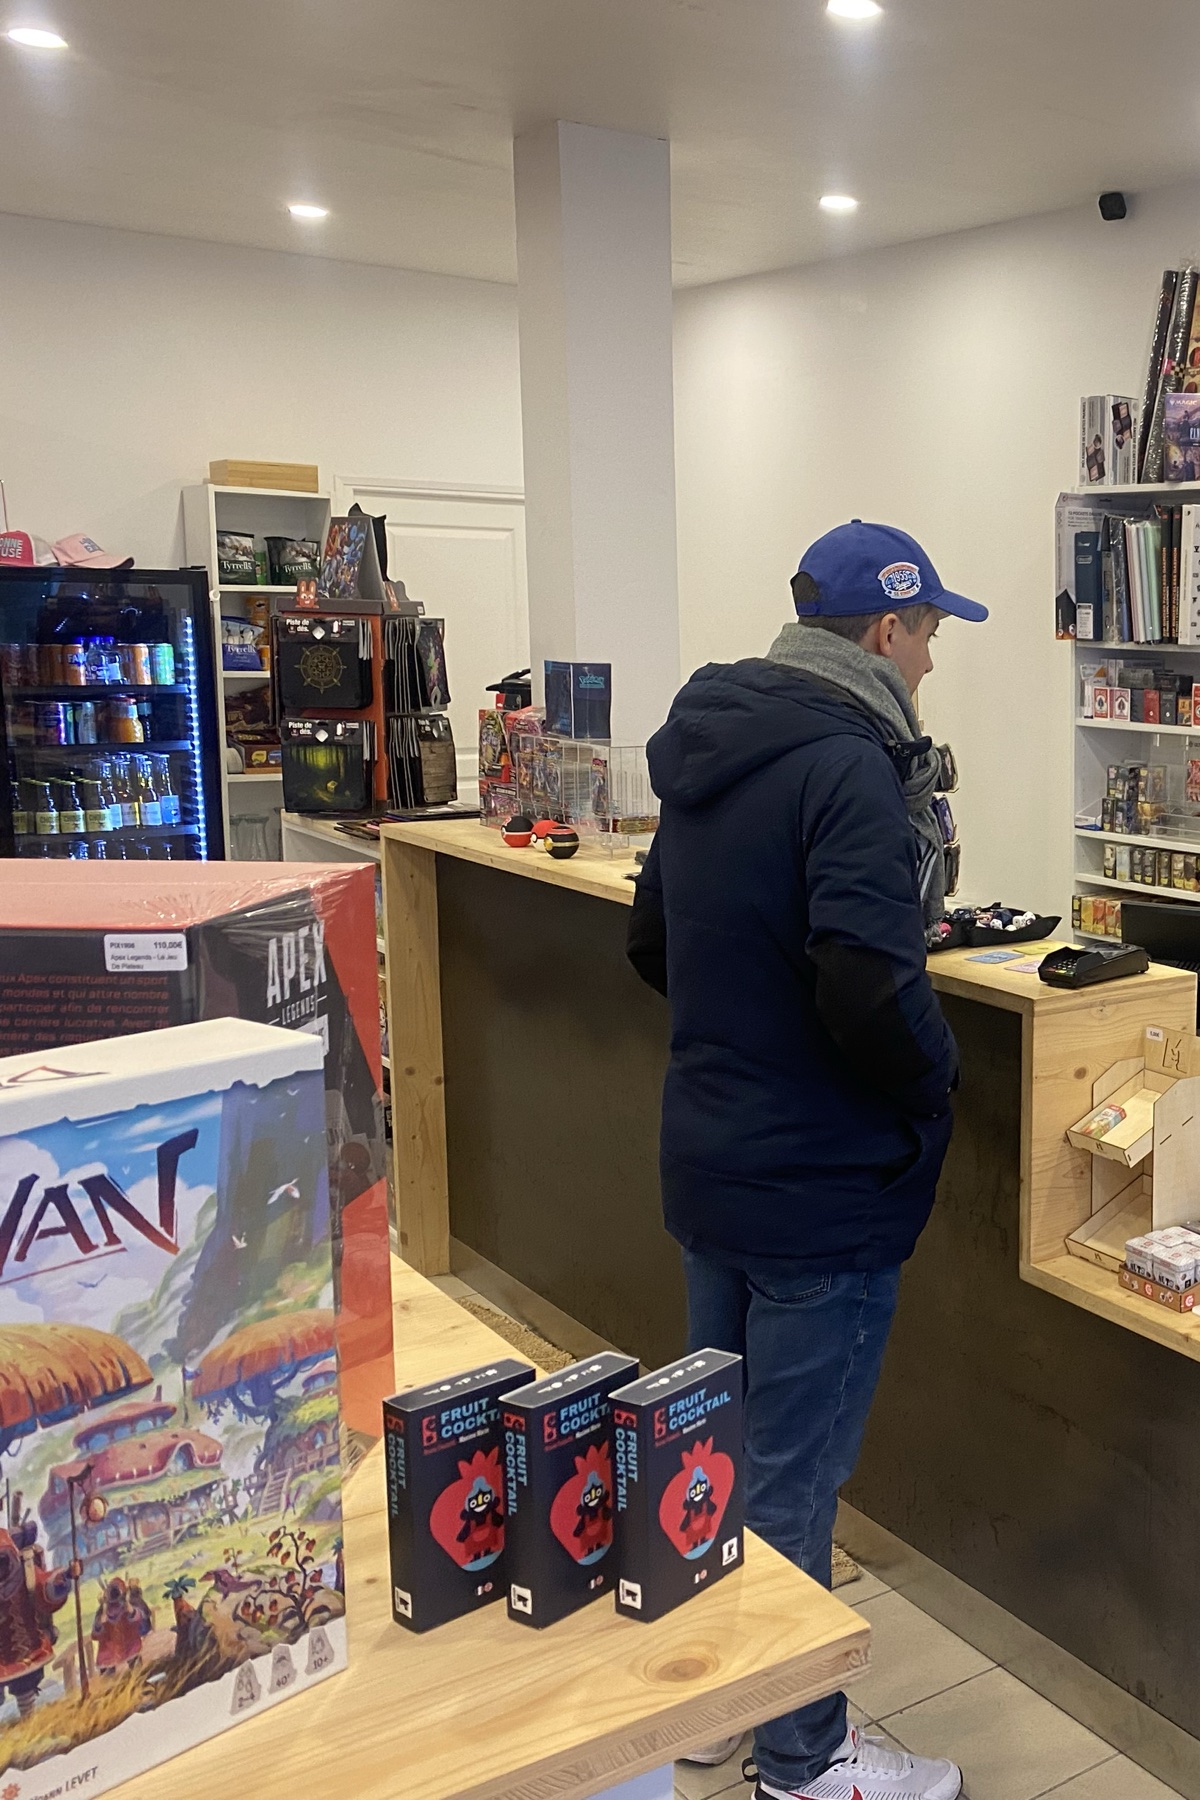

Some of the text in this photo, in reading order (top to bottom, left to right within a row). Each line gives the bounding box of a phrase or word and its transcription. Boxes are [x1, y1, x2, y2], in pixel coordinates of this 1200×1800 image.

[110, 954, 126, 962] Apex
[127, 954, 152, 962] Legends
[267, 919, 327, 1008] APEX
[2, 988, 49, 998] mondes
[67, 989, 86, 1000] qui
[89, 989, 120, 999] attire
[123, 989, 169, 1000] nombre
[18, 974, 47, 985] Apex
[49, 974, 117, 985] constituent
[137, 975, 168, 987] sport
[60, 1003, 82, 1013] afin
[87, 1003, 102, 1013] de
[106, 1004, 169, 1014] rencontrer
[122, 1018, 149, 1028] Avec
[282, 994, 315, 1025] LEGENDS
[440, 1397, 489, 1425] FRUIT
[560, 1392, 601, 1420] FRUIT
[669, 1388, 707, 1416] FRUIT
[669, 1391, 732, 1430] COCKTAIL
[560, 1403, 611, 1435] COCKT
[396, 1437, 406, 1490] FRUIT
[516, 1434, 527, 1487] FRUIT
[615, 1428, 627, 1512] COCKTAIL
[627, 1430, 638, 1483] FRUIT
[388, 1433, 399, 1518] COCKTAIL
[505, 1431, 517, 1517] COCKTAIL
[313, 1656, 330, 1671] 10+
[65, 1765, 98, 1793] LEVET
